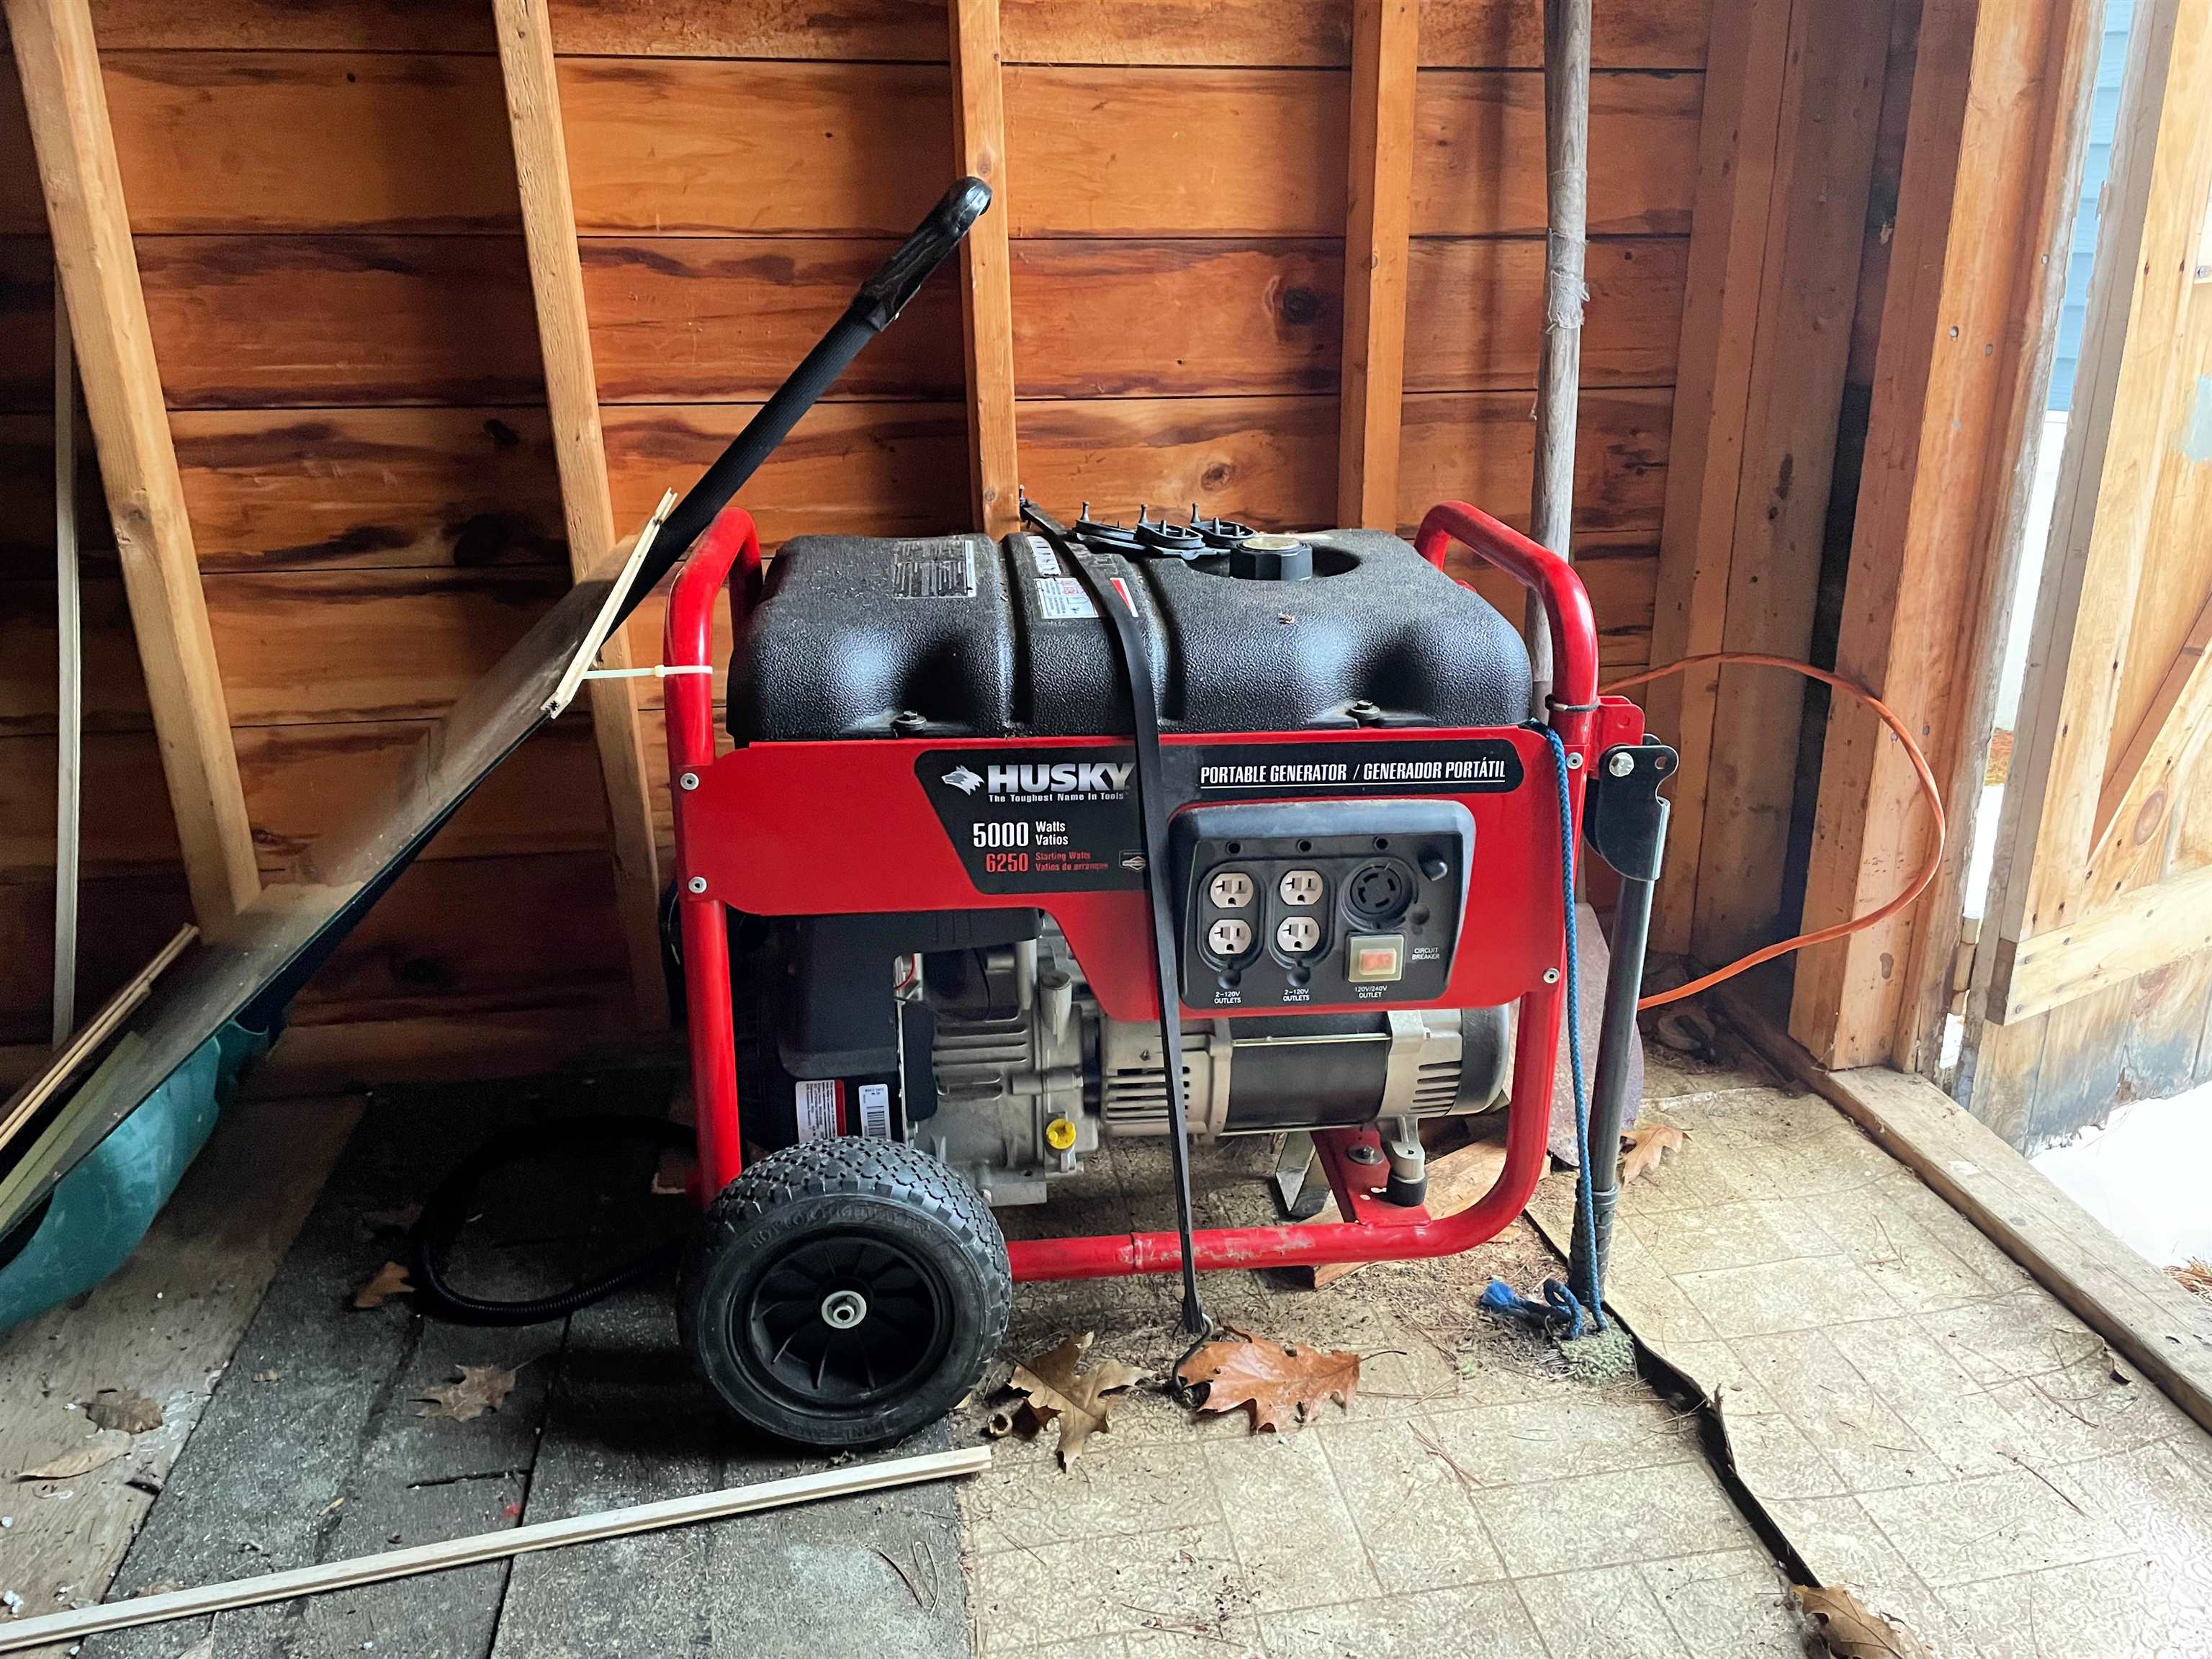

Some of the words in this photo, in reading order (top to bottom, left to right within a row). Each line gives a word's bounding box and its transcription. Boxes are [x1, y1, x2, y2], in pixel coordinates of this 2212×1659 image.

[987, 763, 1135, 793] HUSKY
[1200, 765, 1267, 784] PORTABLE
[1269, 763, 1347, 783] GENERATOR
[1353, 763, 1360, 781] /
[1363, 761, 1442, 781] GENERADOR
[1444, 756, 1506, 778] PORTÁTIL
[989, 794, 1006, 803] The
[1010, 793, 1053, 803] Toughest
[1057, 793, 1084, 801] Name
[973, 822, 1030, 848] 5000
[1035, 821, 1066, 832] Watts
[1035, 834, 1069, 846] Vatios
[986, 853, 1030, 873] 6250
[1035, 852, 1066, 862] Starting
[1069, 851, 1092, 860] Watts
